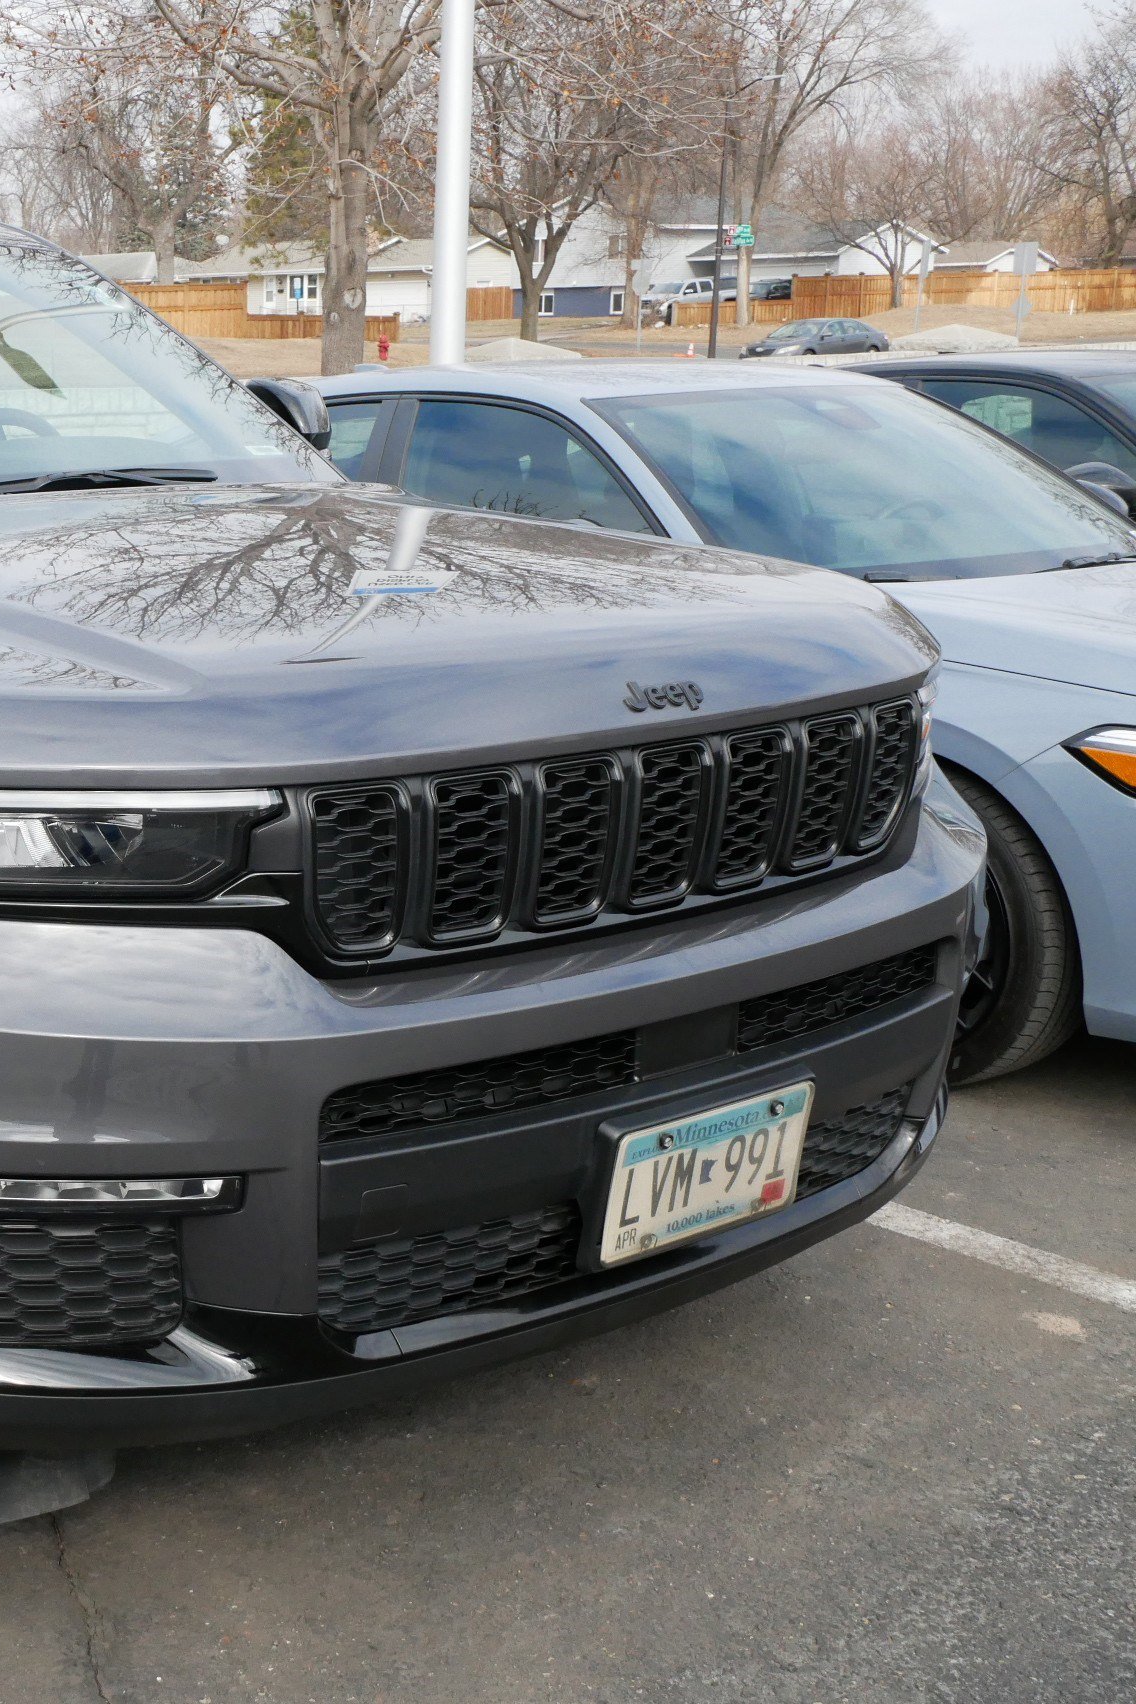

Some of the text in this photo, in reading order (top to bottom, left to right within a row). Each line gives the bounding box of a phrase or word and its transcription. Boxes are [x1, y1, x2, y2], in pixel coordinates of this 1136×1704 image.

[623, 680, 704, 713] Jeep
[675, 1109, 759, 1143] Minnesota
[725, 1121, 788, 1193] 991
[705, 1204, 735, 1219] lakes
[615, 1228, 637, 1252] APR
